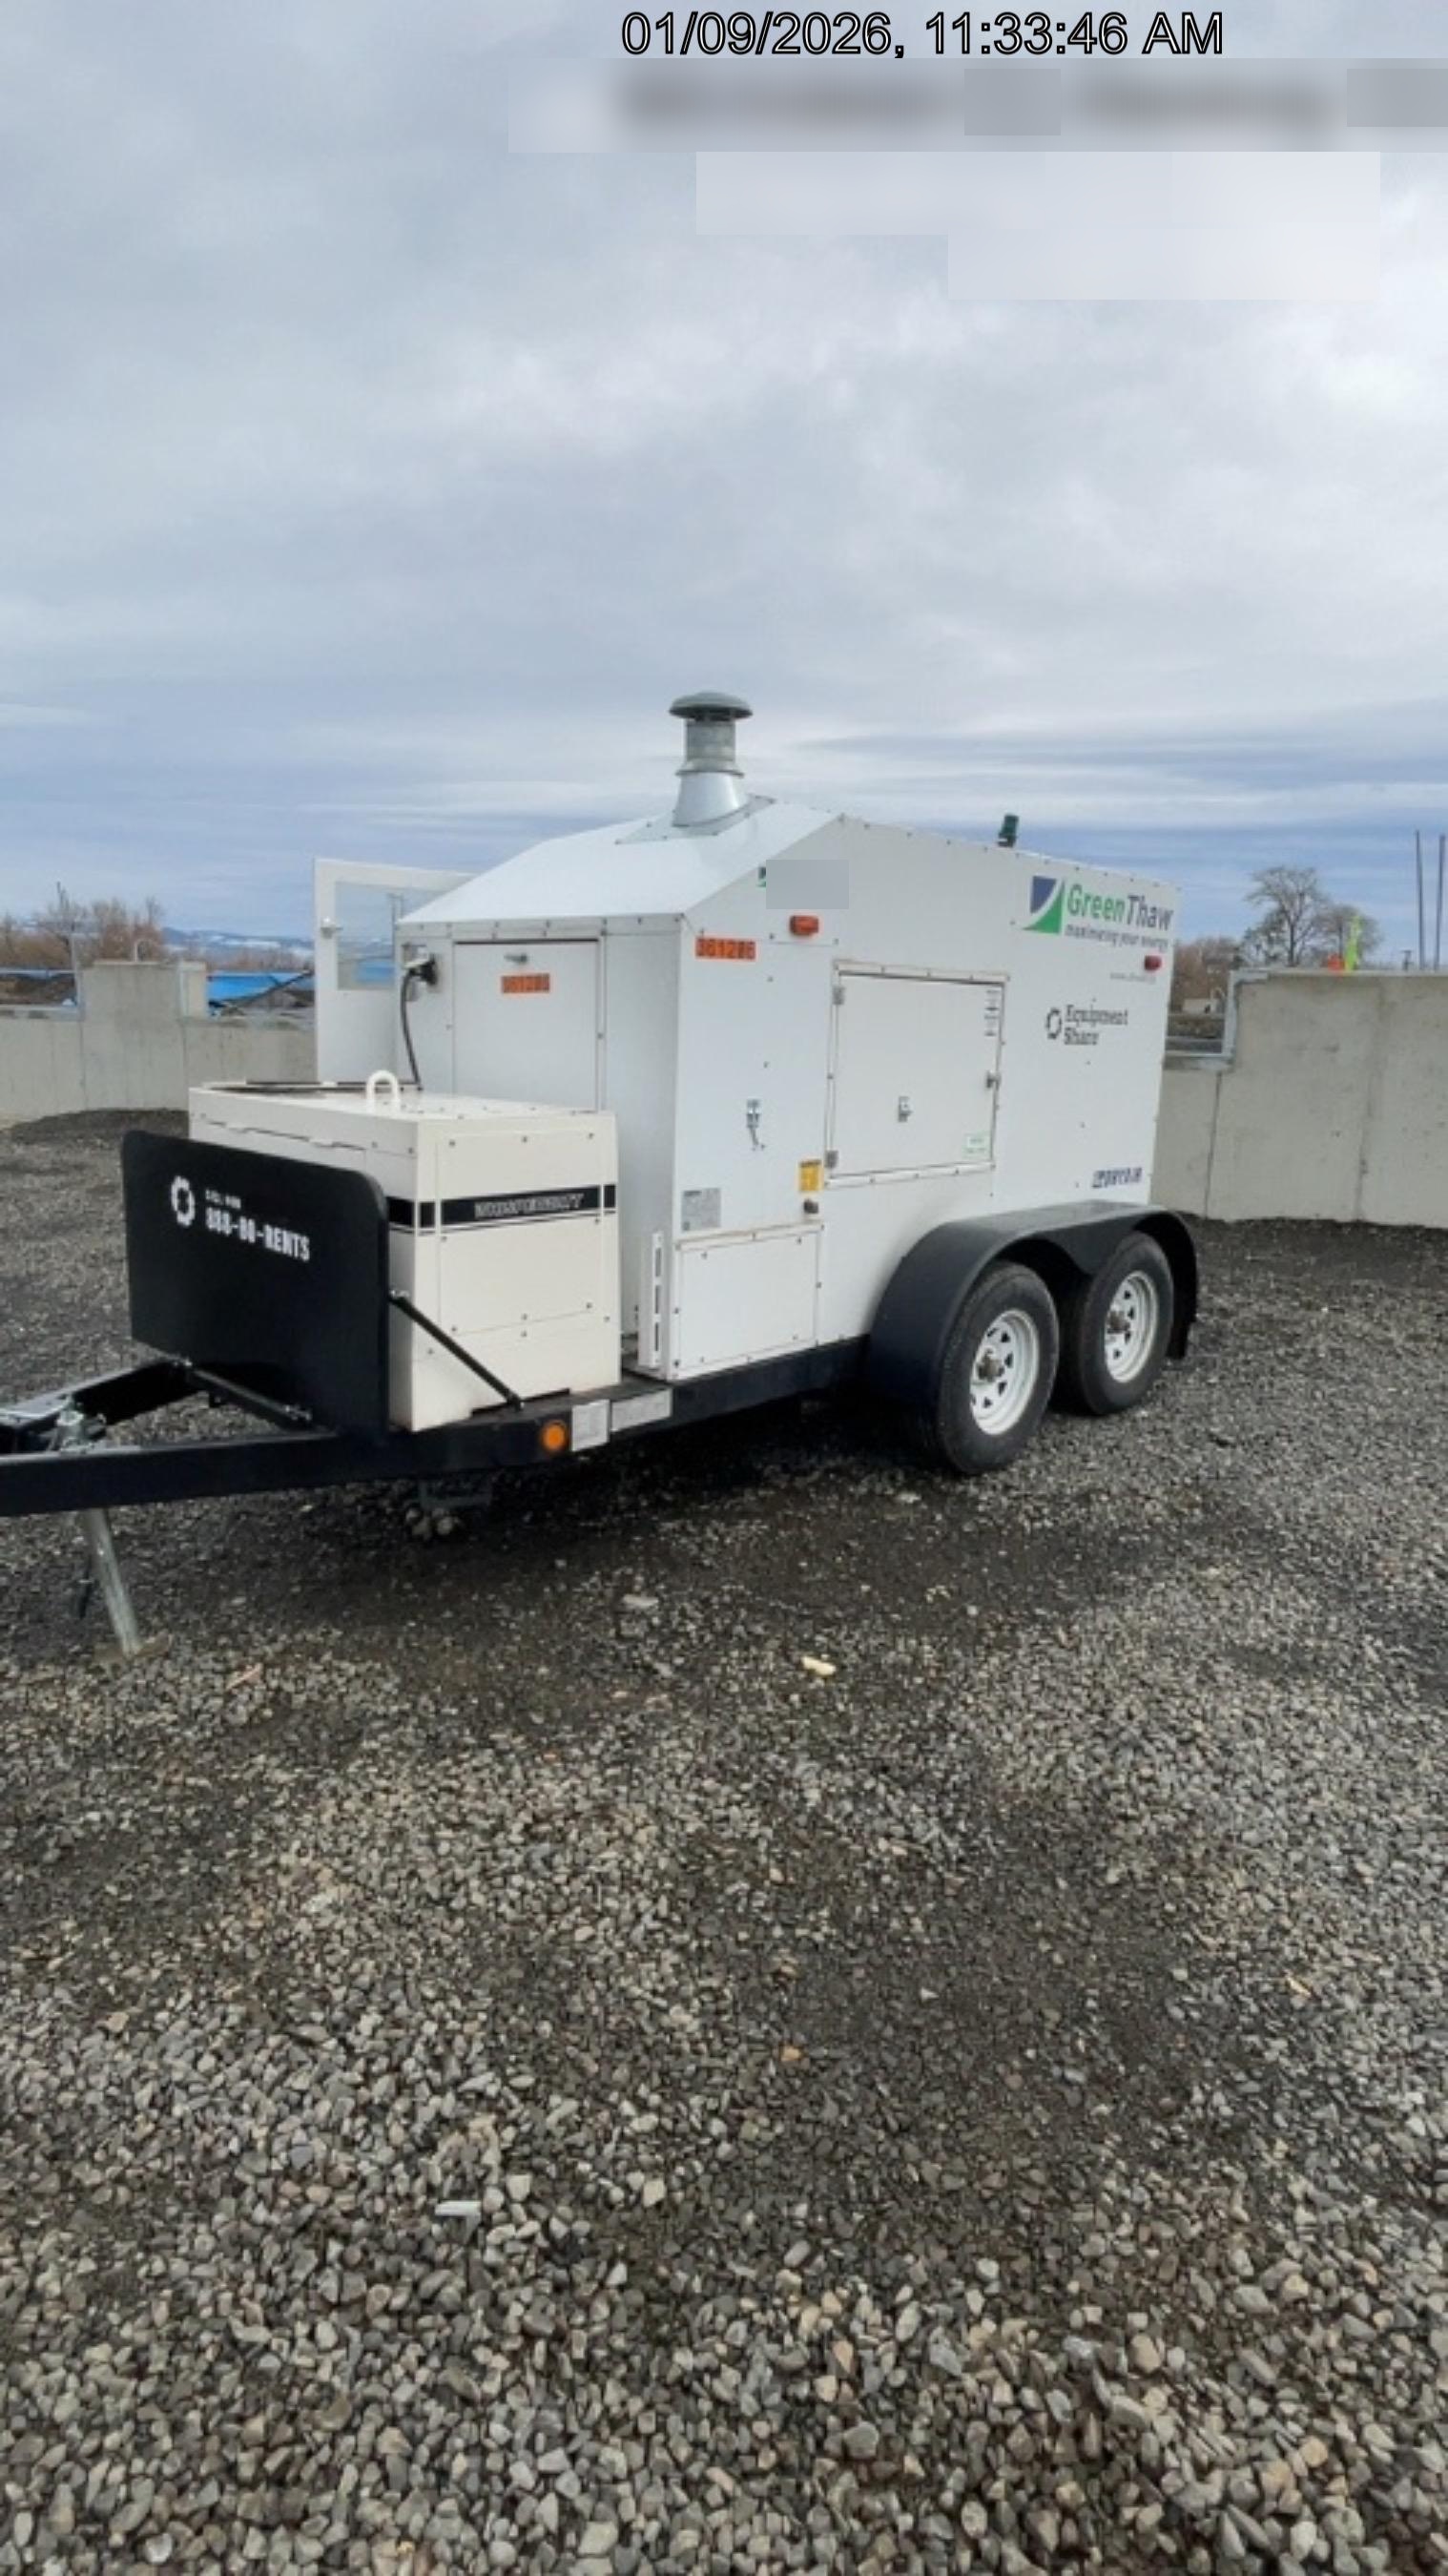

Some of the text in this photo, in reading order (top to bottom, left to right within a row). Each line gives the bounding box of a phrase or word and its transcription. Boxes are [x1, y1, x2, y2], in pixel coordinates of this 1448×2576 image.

[1067, 883, 1173, 931] GreenThaw
[1065, 1004, 1128, 1028] Equipment
[1064, 1027, 1100, 1046] Share
